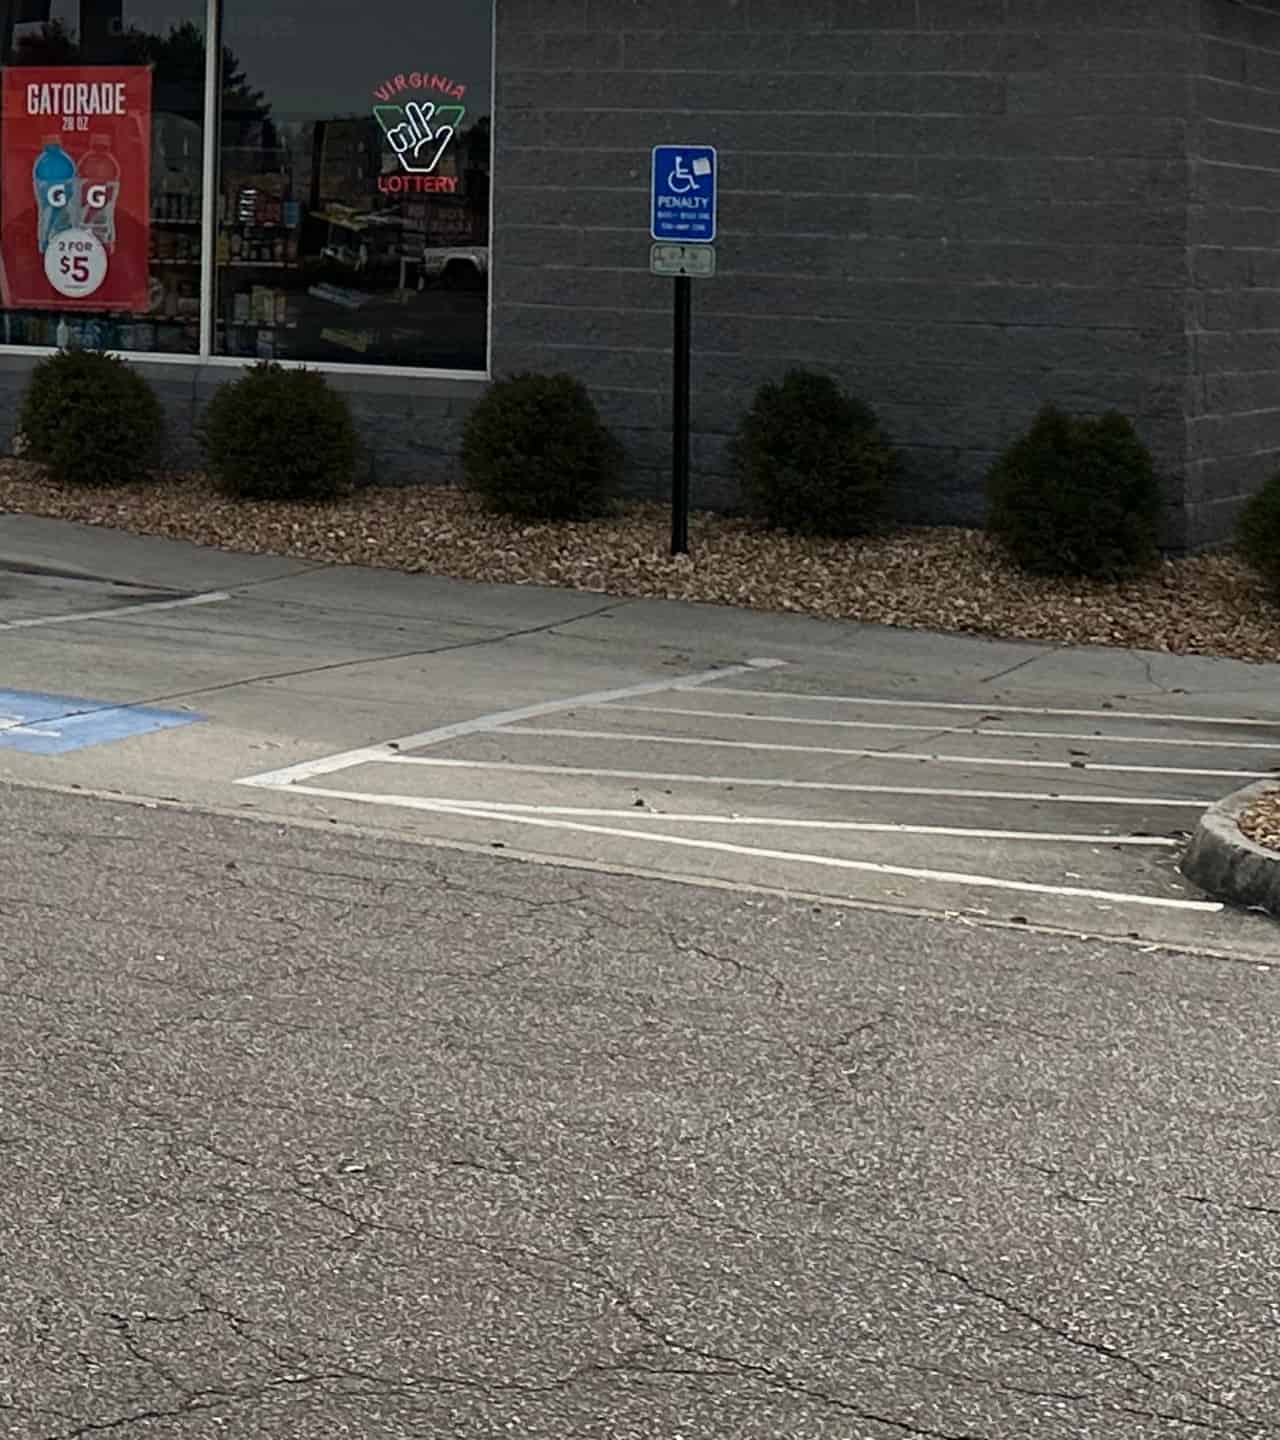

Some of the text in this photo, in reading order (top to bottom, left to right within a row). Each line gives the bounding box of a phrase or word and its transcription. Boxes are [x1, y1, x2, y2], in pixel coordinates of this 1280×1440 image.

[371, 71, 467, 102] VIRGINIA
[26, 83, 127, 115] GATORADE
[76, 116, 88, 131] OZ
[47, 184, 68, 208] G
[376, 175, 459, 193] LOTTERY
[86, 185, 108, 209] G
[657, 194, 708, 209] PENALTY
[59, 242, 92, 252] 2 FOR
[60, 256, 89, 283] $5
